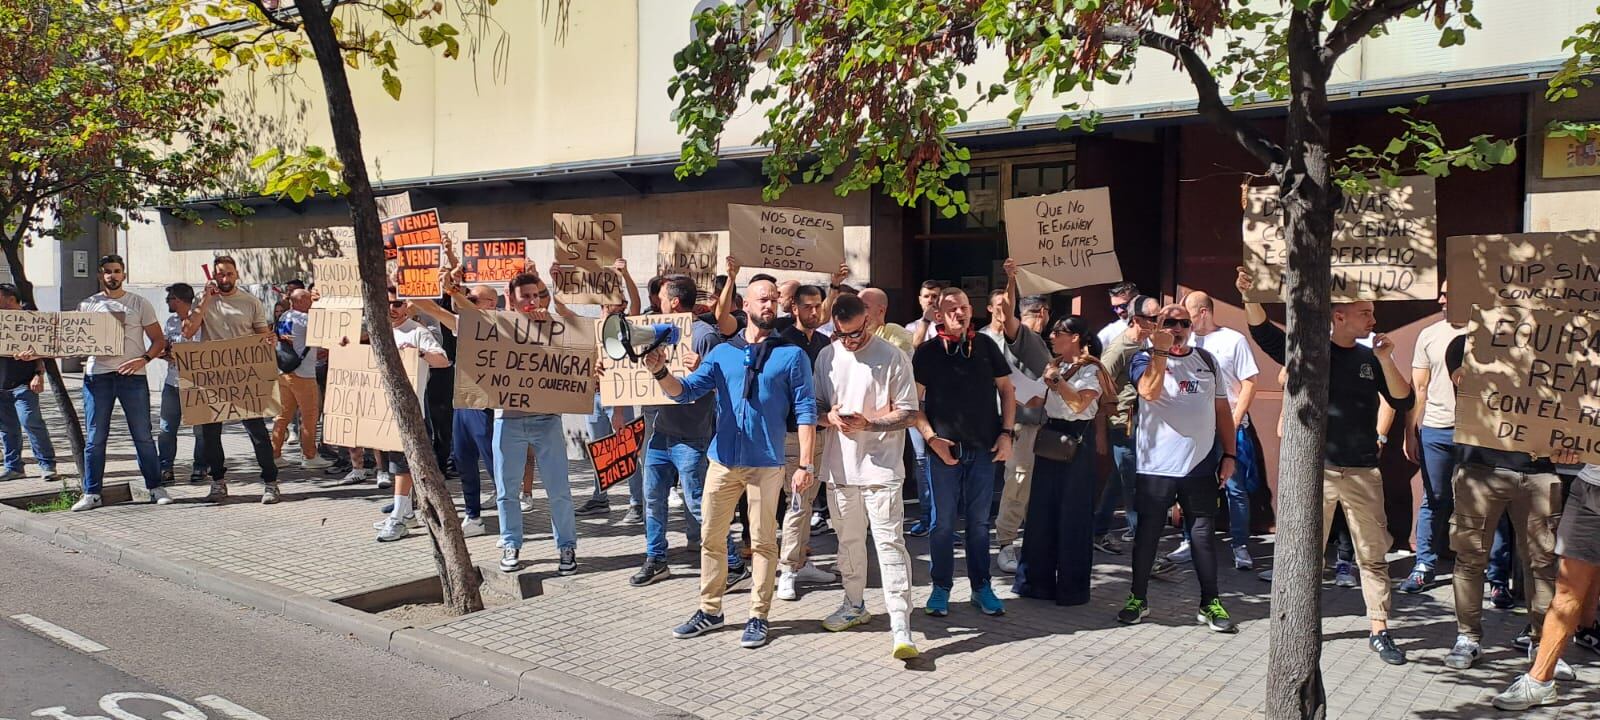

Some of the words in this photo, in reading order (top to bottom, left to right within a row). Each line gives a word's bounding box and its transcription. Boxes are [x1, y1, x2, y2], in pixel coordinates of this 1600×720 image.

[1067, 199, 1085, 215] NO
[397, 211, 438, 233] VENDE
[760, 210, 787, 223] NOS
[792, 213, 835, 231] DEBEIS
[1037, 220, 1050, 236] TE
[463, 244, 480, 257] SE
[484, 241, 525, 257] VENDE
[566, 241, 599, 262] SE
[760, 243, 806, 258] DESDE
[1038, 239, 1054, 251] NO
[1061, 234, 1099, 248] ENTRES
[406, 248, 440, 266] VENDE
[486, 258, 514, 271] UIP
[763, 257, 814, 271] AGOSTO
[1041, 255, 1052, 269] A
[1070, 249, 1095, 268] UIP
[1358, 269, 1414, 293] LUJO
[1500, 263, 1546, 284] UIP
[1552, 263, 1600, 282] SIN
[20, 333, 45, 343] QUE
[475, 321, 499, 342] LA
[514, 318, 565, 346] UIP
[475, 349, 499, 368] SE
[505, 350, 591, 377] DESANGRA
[191, 366, 261, 390] JORNADA
[475, 373, 487, 385] Y
[490, 373, 511, 387] NO
[518, 376, 534, 388] LO
[538, 377, 588, 394] QUIEREN
[185, 382, 269, 408] LABORAL
[498, 391, 531, 408] VER
[1486, 391, 1530, 415] CON
[1537, 400, 1569, 422] EL
[1497, 421, 1529, 442] DE
